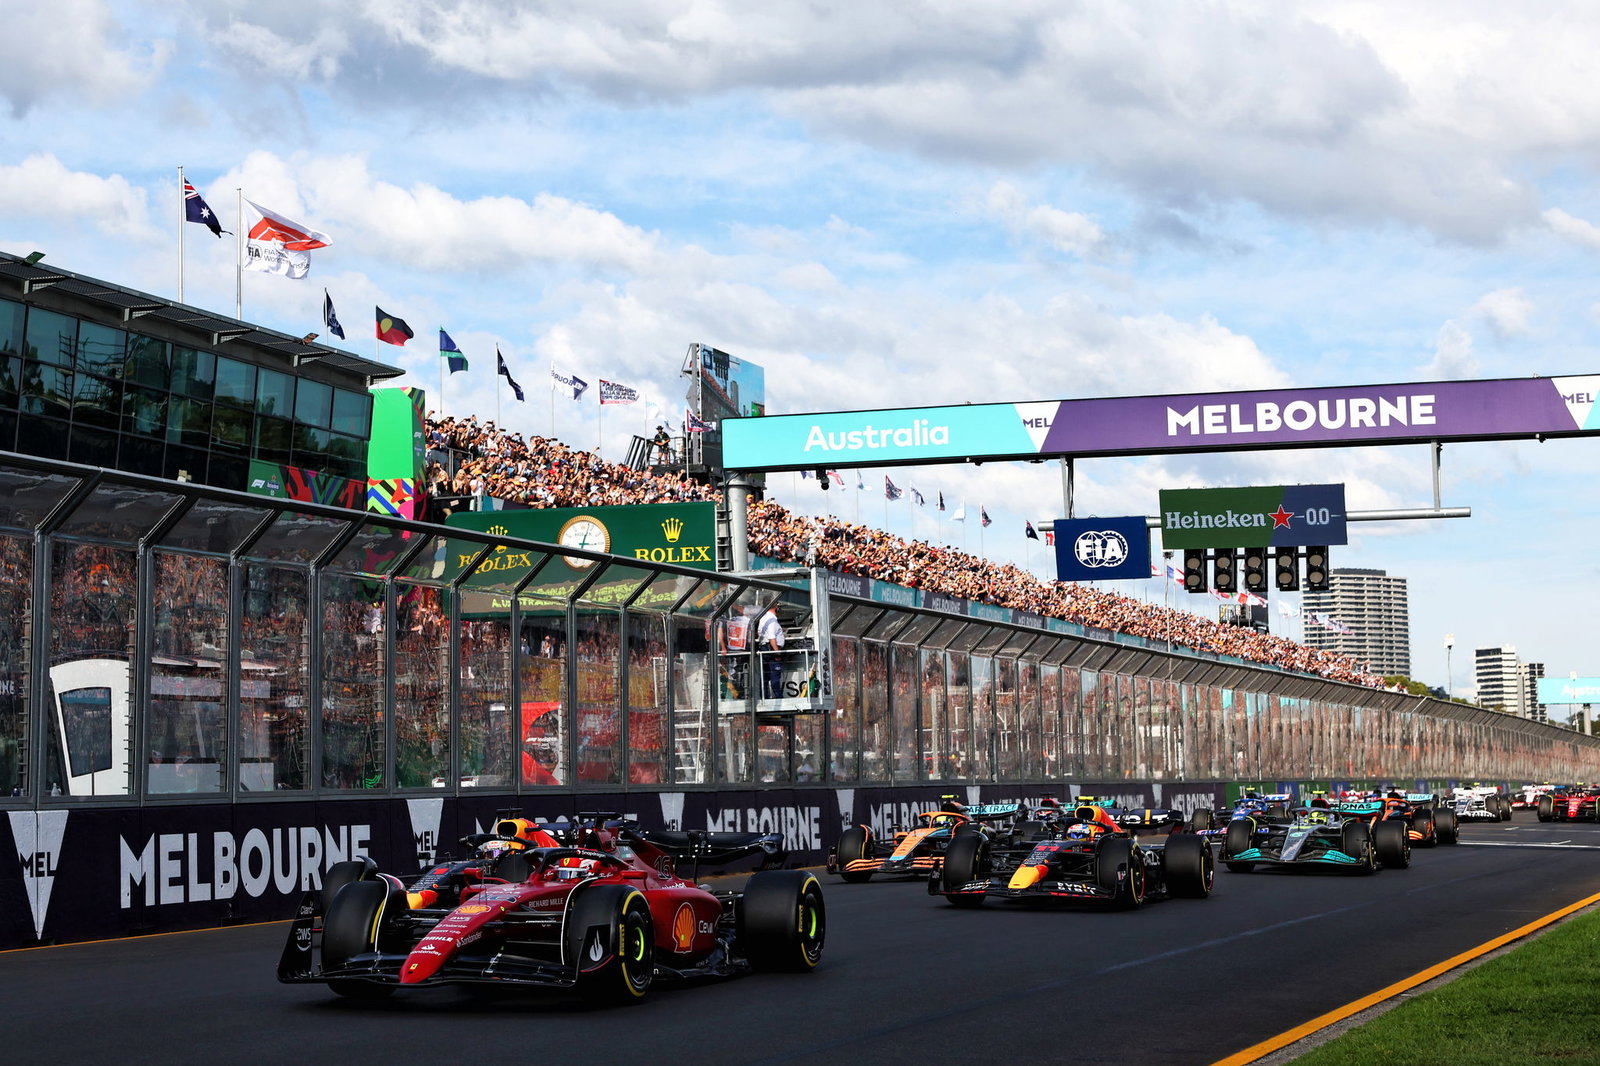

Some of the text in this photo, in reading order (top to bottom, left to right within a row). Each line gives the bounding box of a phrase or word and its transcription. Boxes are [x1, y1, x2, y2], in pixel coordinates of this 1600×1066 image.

[1562, 392, 1595, 404] MEL
[1022, 417, 1052, 428] MEL
[1167, 395, 1436, 436] MELBOURNE
[804, 419, 949, 451] Australia
[1165, 510, 1266, 530] Heineken
[634, 546, 712, 563] ROLEX
[706, 805, 821, 851] MELBOURNE
[414, 831, 438, 852] MEL
[581, 850, 607, 858] Snapdragon
[20, 851, 57, 878] MEL
[120, 825, 371, 909] MELBOURNE
[654, 855, 673, 880] 16
[528, 897, 564, 908] RICHARD MILLE
[461, 931, 483, 947] Santander
